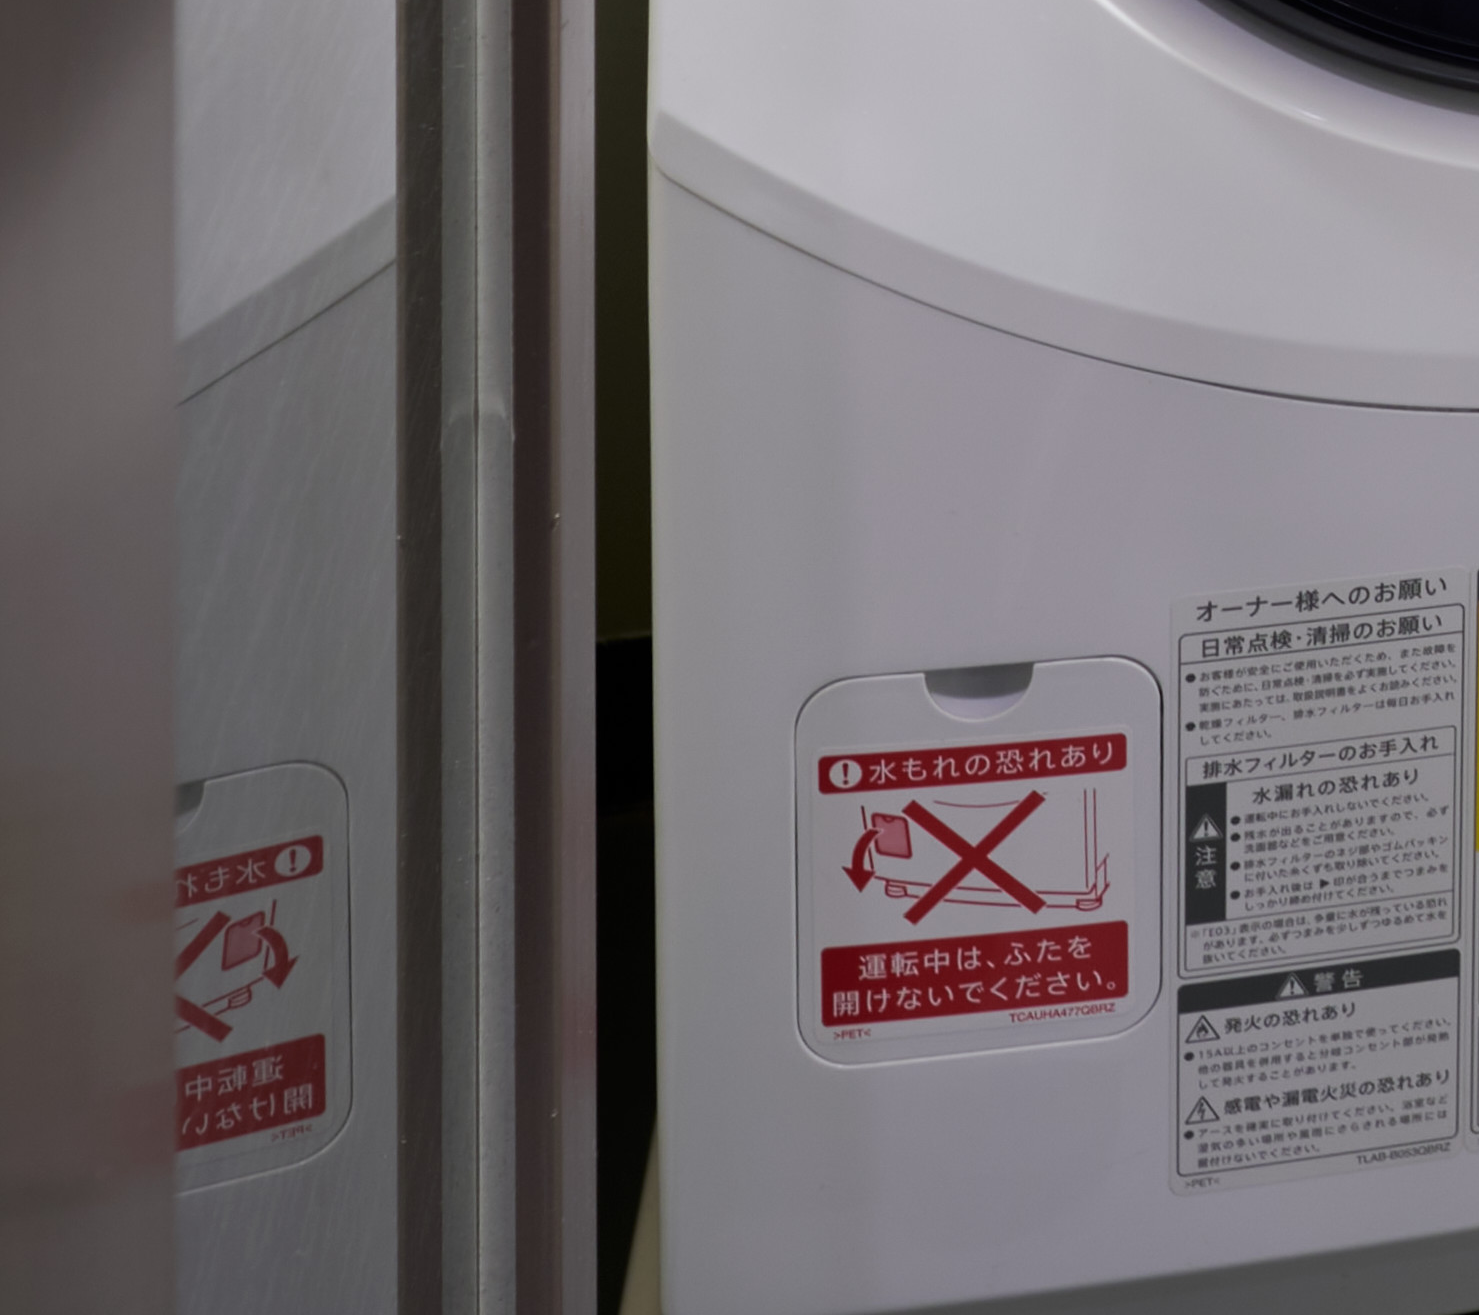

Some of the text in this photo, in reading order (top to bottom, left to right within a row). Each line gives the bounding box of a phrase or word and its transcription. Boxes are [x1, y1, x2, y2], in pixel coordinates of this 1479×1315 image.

[1197, 577, 1447, 622] オーナー様へのお願い
[869, 741, 1113, 784] 水もれの恐れあり
[1202, 735, 1439, 779] 排水フィルターのお手入れ
[1253, 769, 1418, 804] 水漏れの恐れあり
[859, 936, 1091, 981] 運転中は、ふたを
[833, 970, 1115, 1016] 開けないでください。
[1225, 1002, 1356, 1034] 発火の恐れあり
